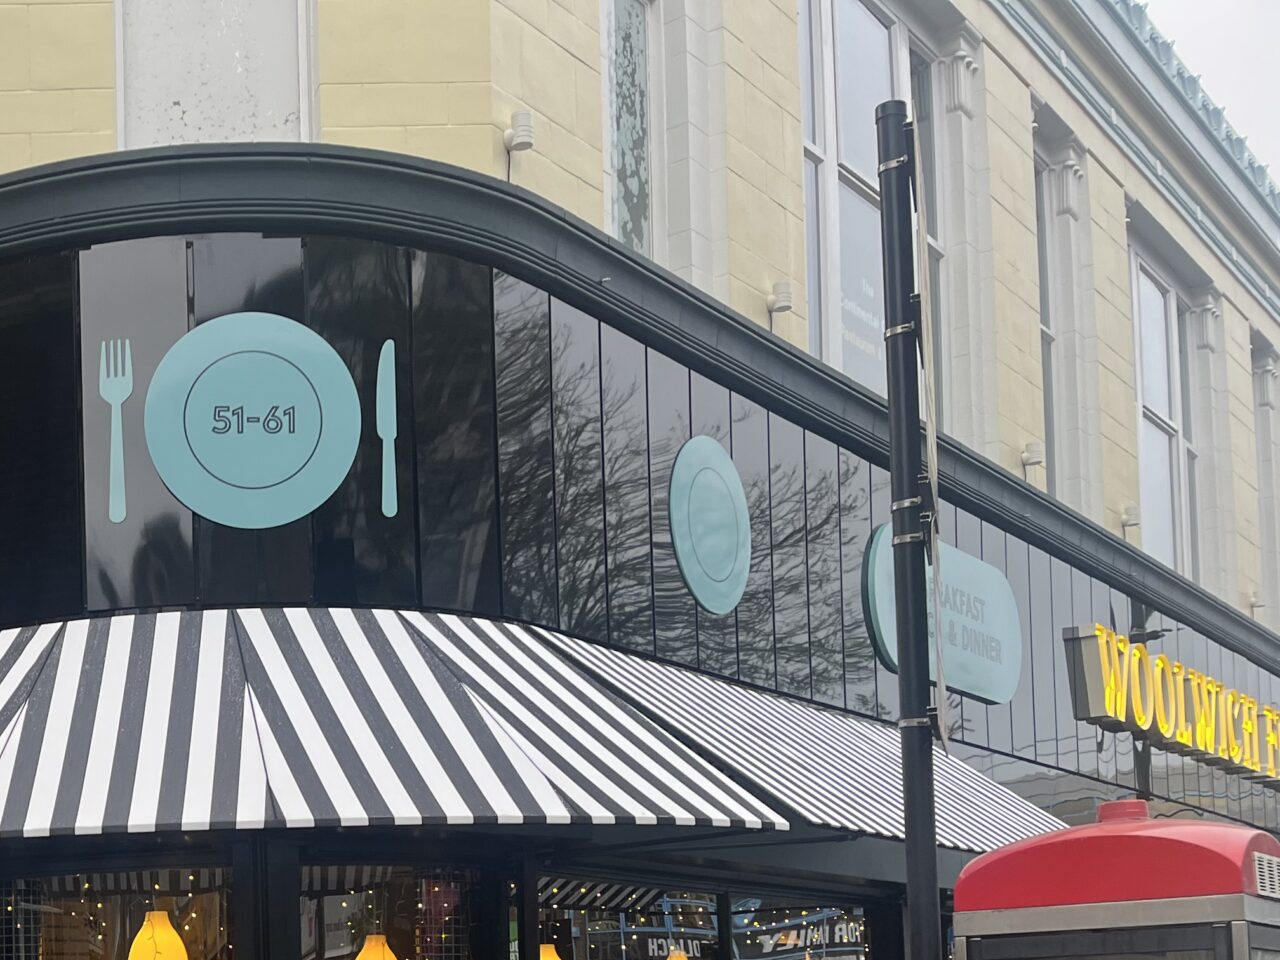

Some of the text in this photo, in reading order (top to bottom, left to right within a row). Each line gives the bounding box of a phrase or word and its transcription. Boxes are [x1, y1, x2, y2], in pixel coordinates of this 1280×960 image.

[211, 405, 296, 434] 51-61
[948, 619, 957, 647] &
[961, 624, 1002, 665] DINNER
[1094, 622, 1261, 773] WOOLWICH
